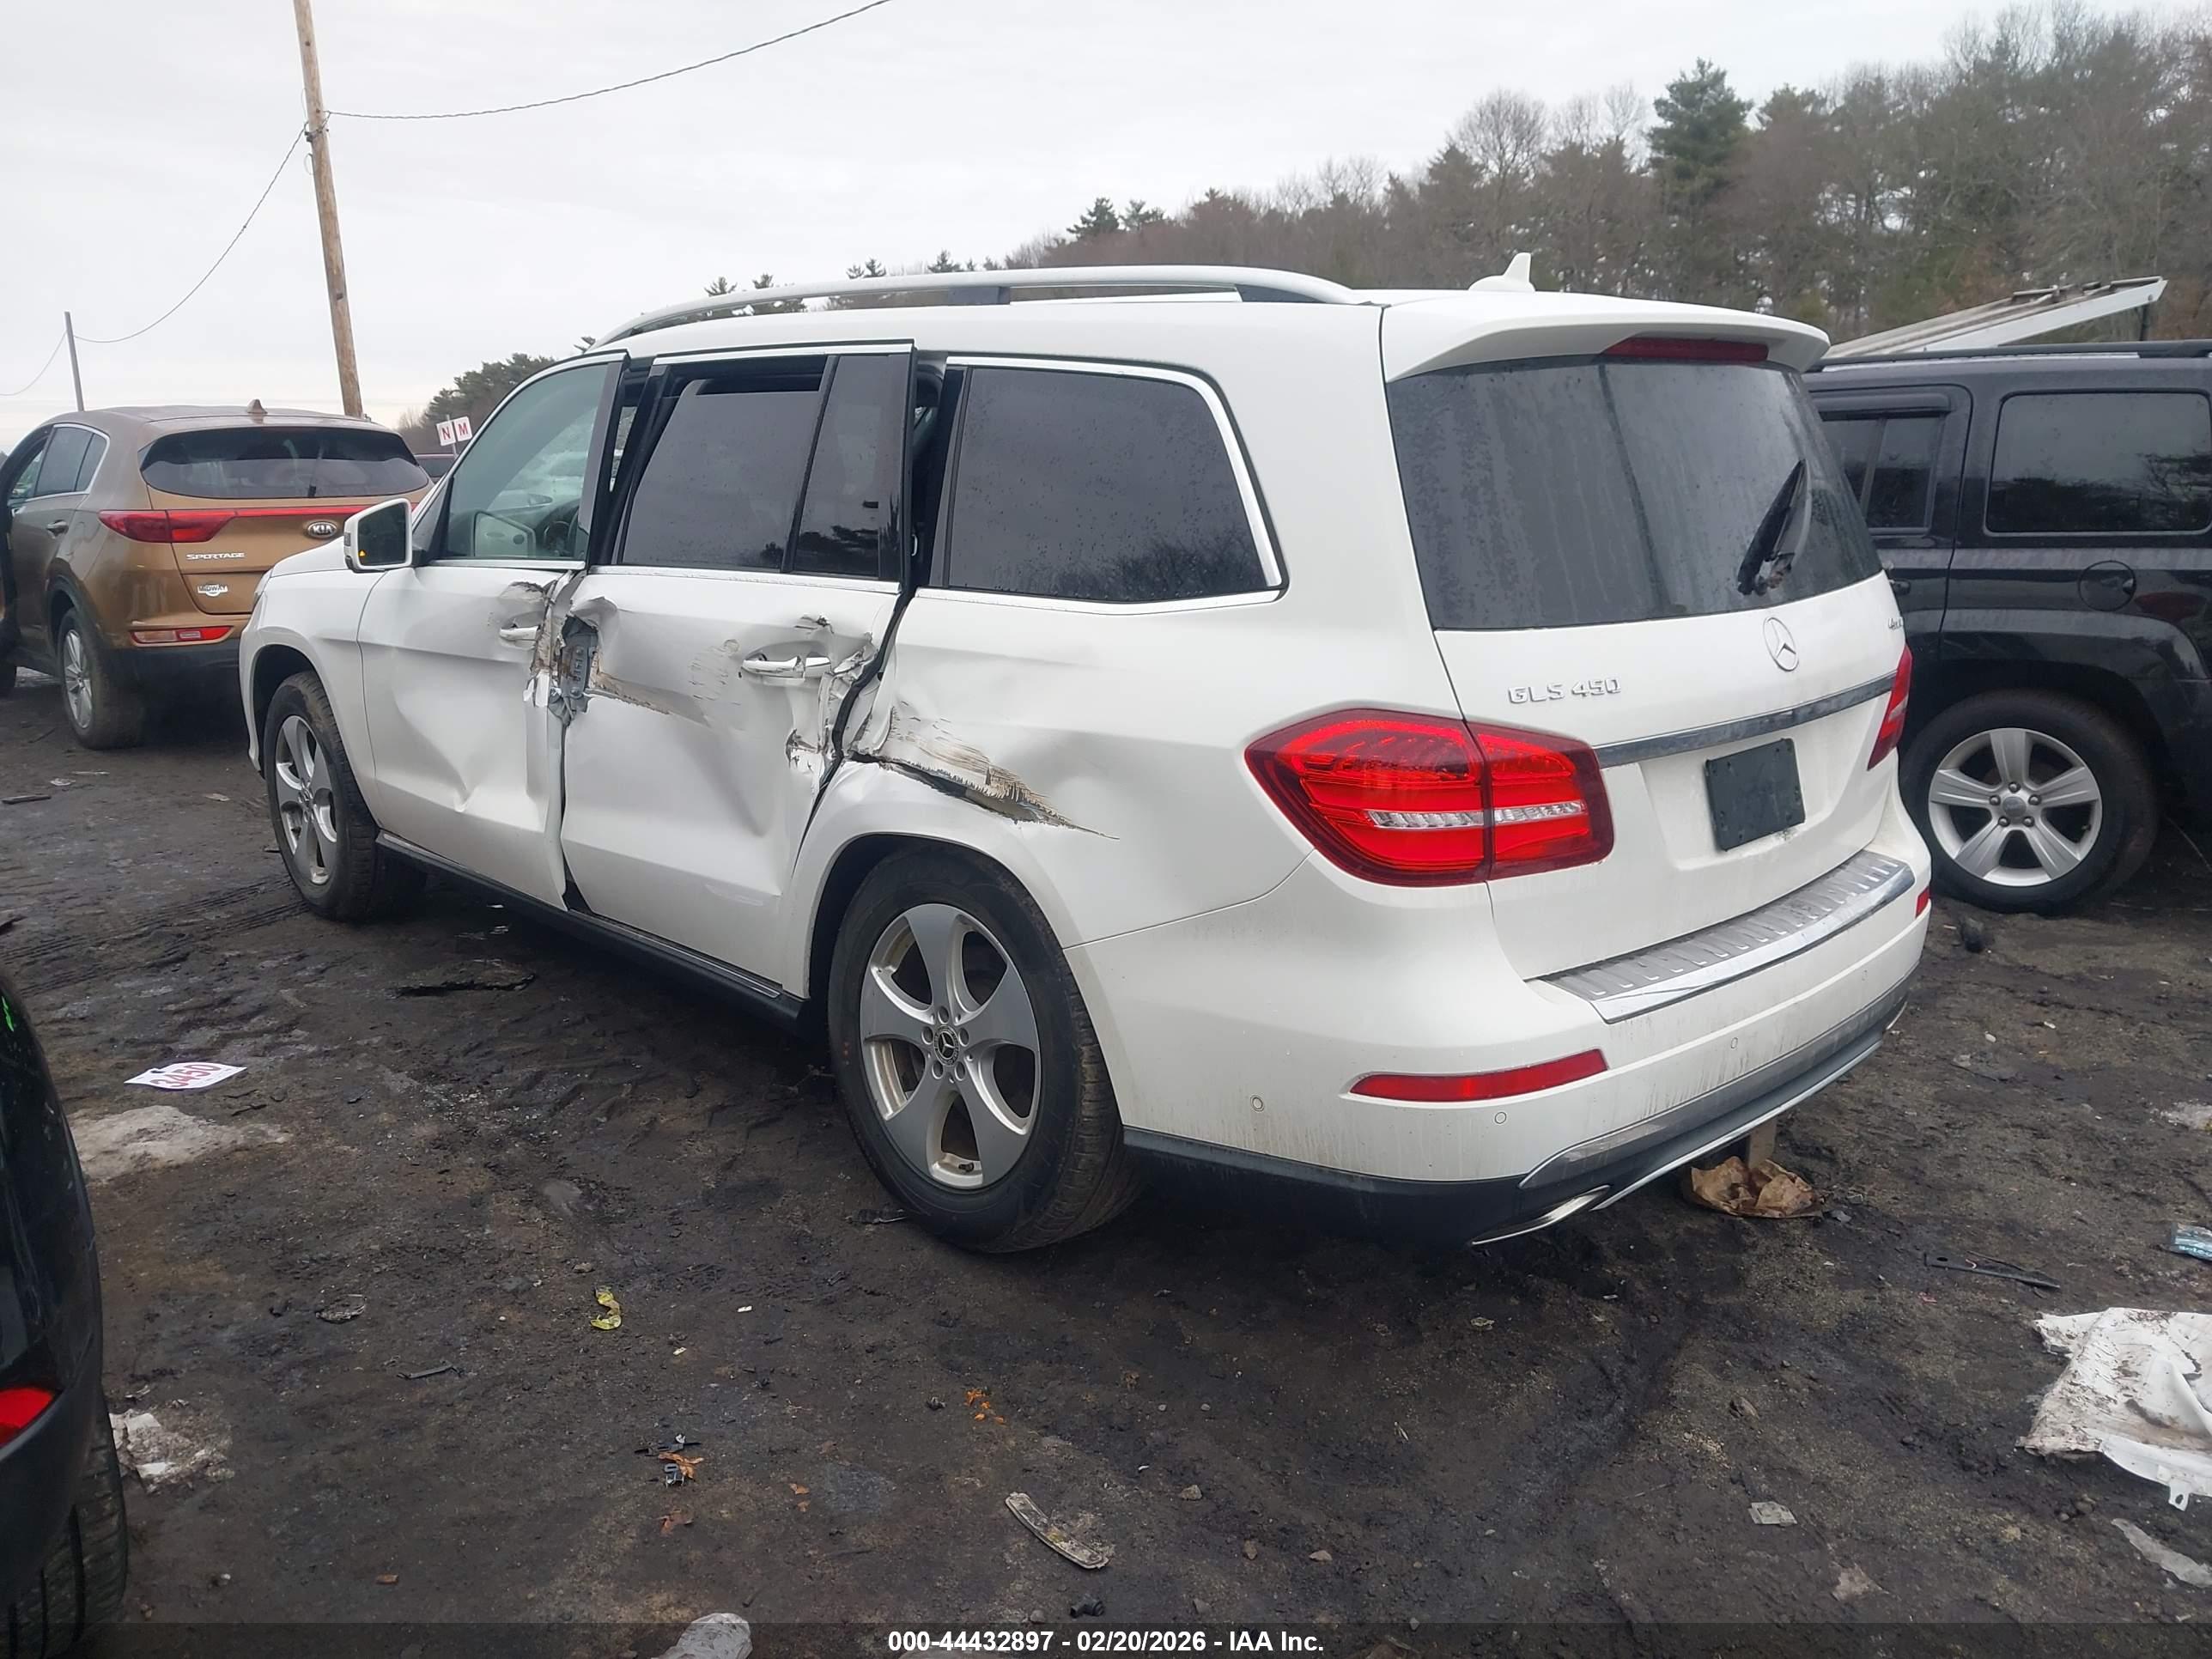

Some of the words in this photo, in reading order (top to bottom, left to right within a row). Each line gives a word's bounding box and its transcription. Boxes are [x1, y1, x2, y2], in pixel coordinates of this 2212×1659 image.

[441, 427, 451, 441] N
[458, 422, 469, 436] M
[312, 524, 333, 535] KIA
[186, 552, 246, 561] SPORTAGE
[1508, 683, 1565, 704] GLS
[1571, 677, 1622, 697] 450
[149, 1064, 222, 1088] 3450
